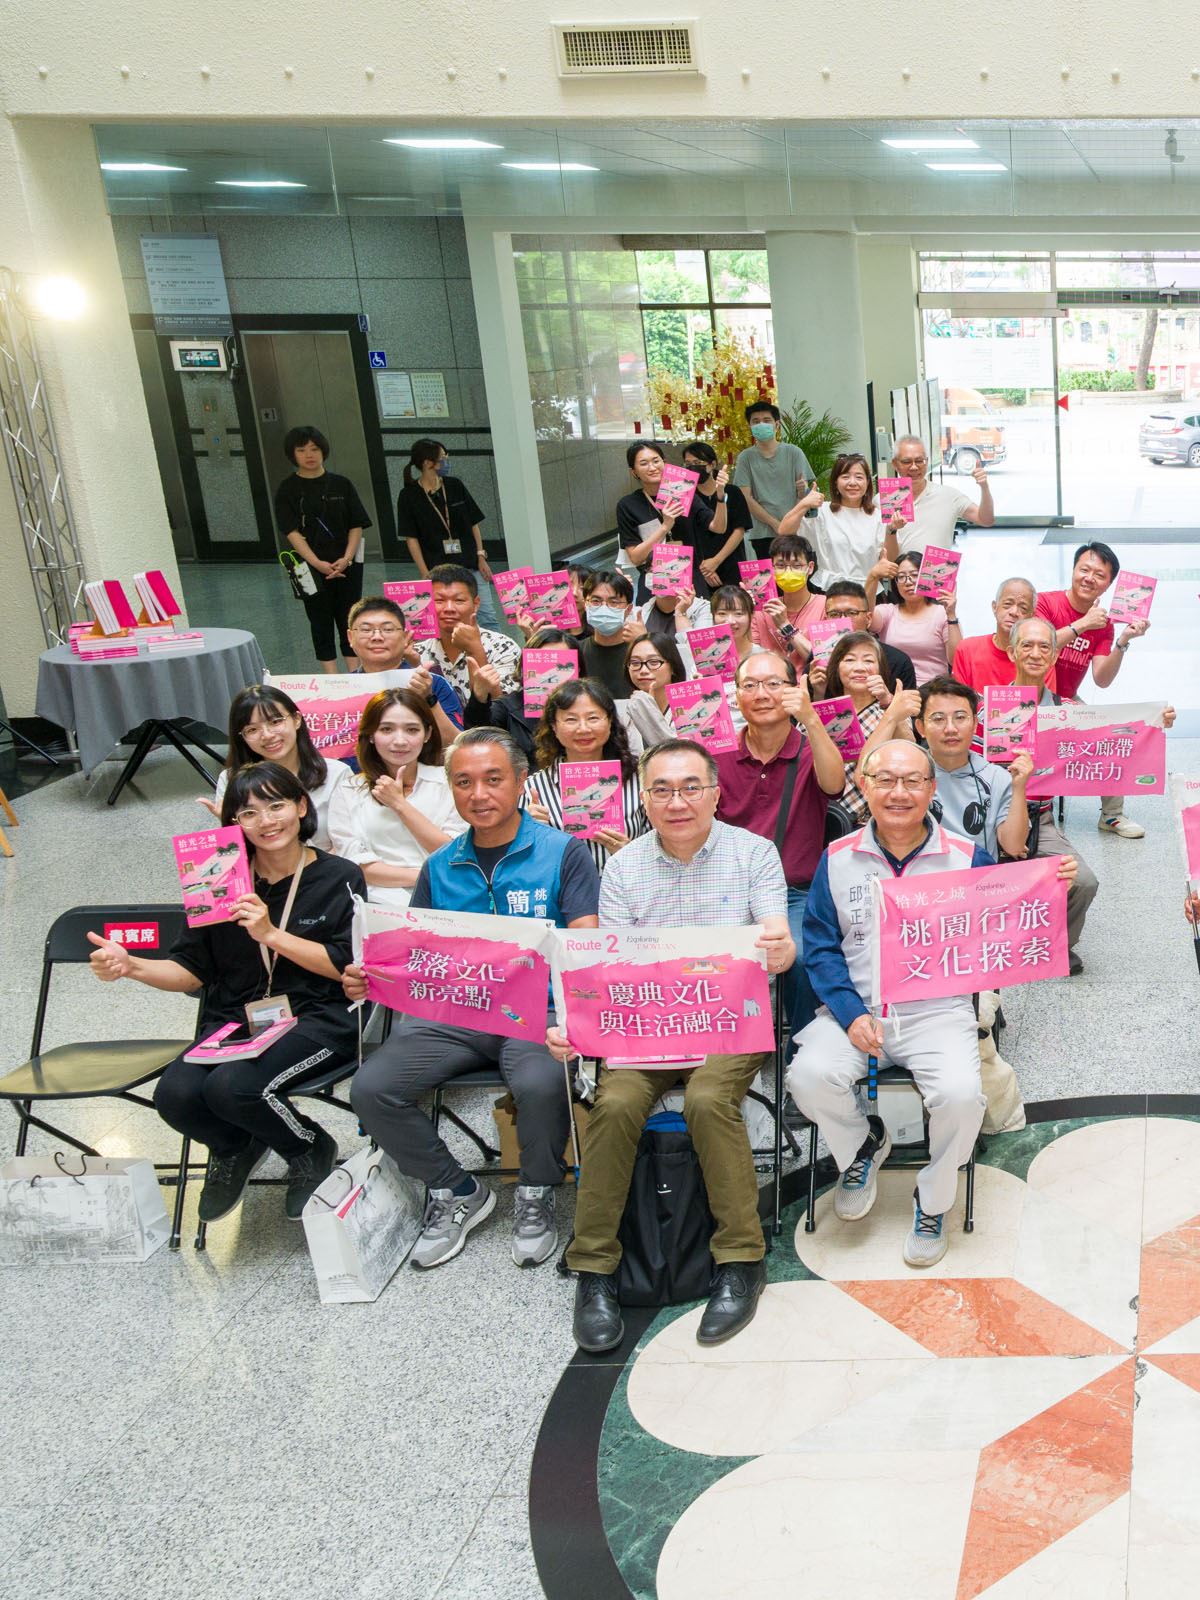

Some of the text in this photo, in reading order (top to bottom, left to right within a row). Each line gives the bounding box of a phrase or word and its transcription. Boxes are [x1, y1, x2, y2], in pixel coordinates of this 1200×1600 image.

[280, 678, 320, 693] Route 4
[1037, 709, 1068, 721] oute 3
[1056, 738, 1134, 759] 藝文廊帶
[1065, 761, 1122, 781] 的活力
[506, 889, 531, 915] 簡
[533, 888, 548, 918] 桃園
[895, 887, 966, 909] 拾光之城
[849, 885, 865, 947] 邱正生
[898, 898, 1050, 948] 桃園行旅
[108, 928, 156, 943] 貴賓席
[566, 934, 620, 953] Route 2
[626, 936, 660, 944] Exploring
[402, 948, 506, 983] 聚落文化
[899, 936, 1051, 984] 文化探索
[408, 979, 492, 1012] 新亮點
[607, 979, 722, 1008] 慶典文化
[599, 1007, 739, 1038] 與生活融合
